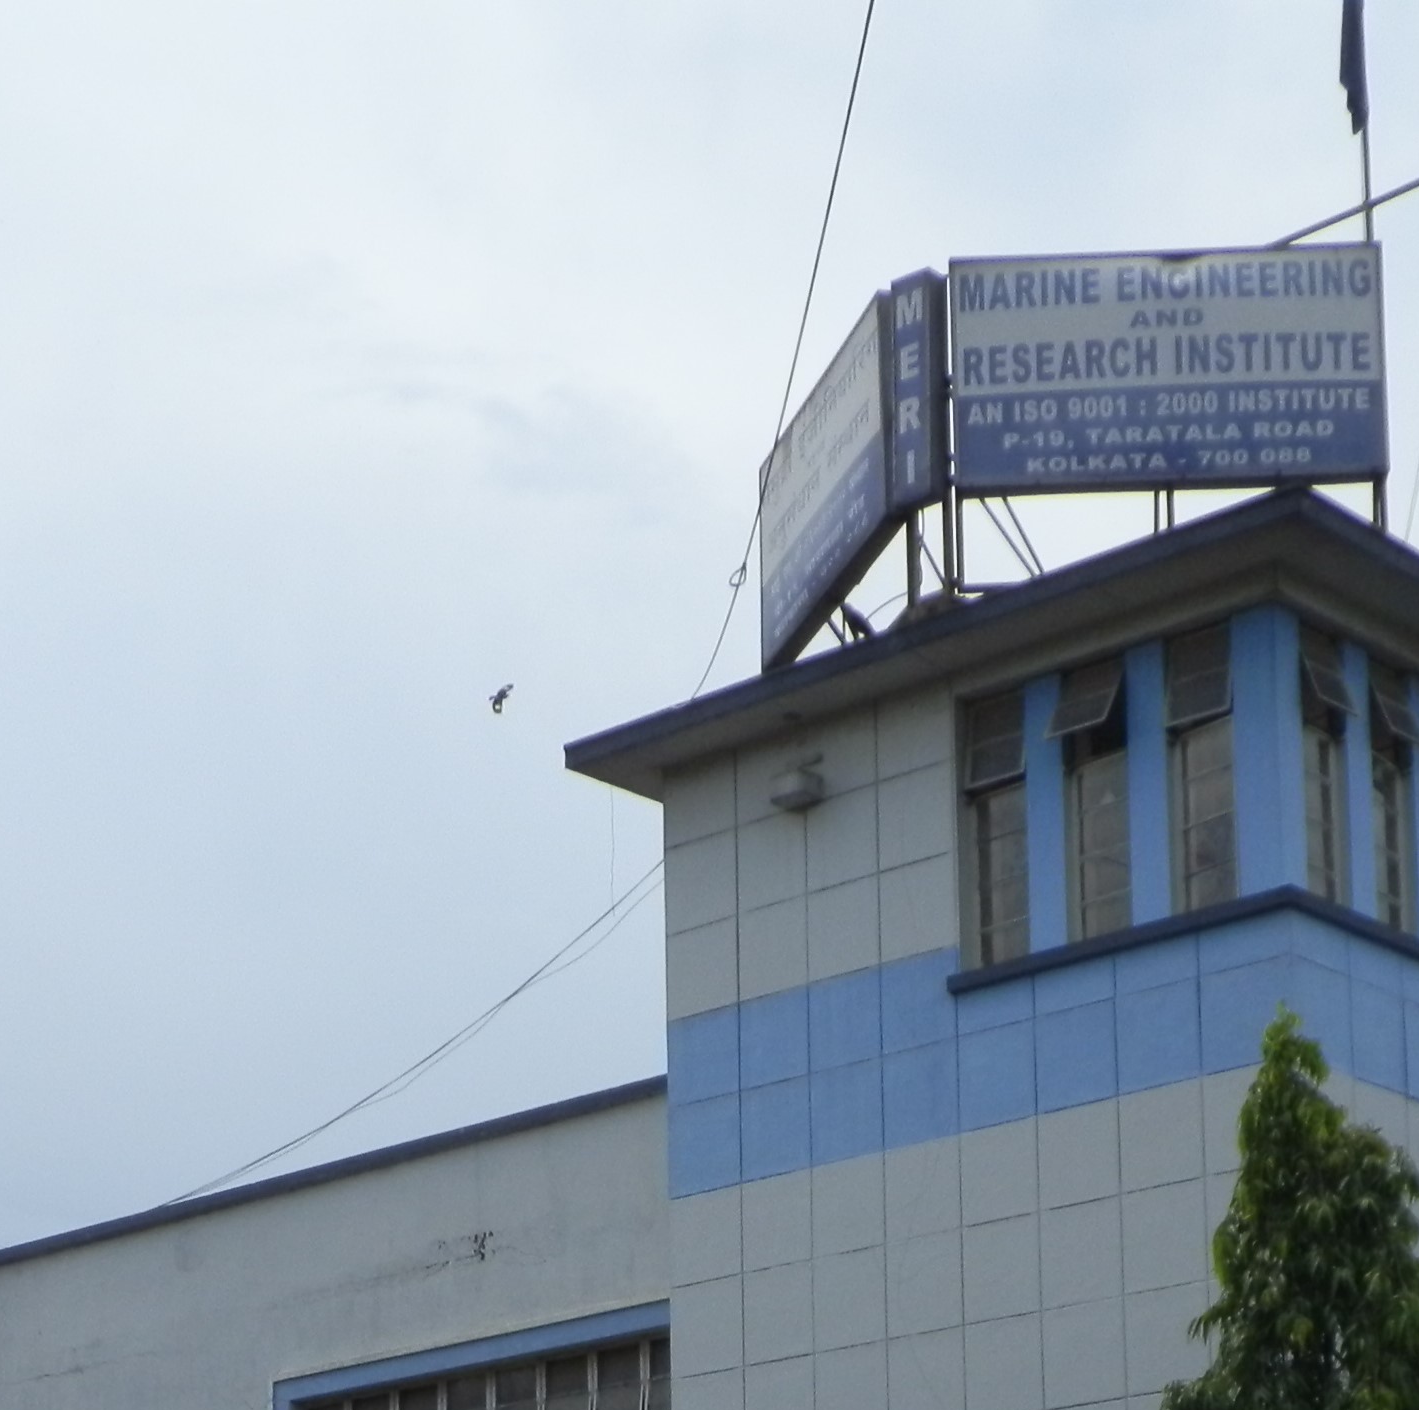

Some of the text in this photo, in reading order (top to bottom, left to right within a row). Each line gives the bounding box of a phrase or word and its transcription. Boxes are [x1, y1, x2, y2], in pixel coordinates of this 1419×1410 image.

[959, 258, 1371, 312] MARINE ENGINEERING
[1130, 308, 1204, 328] AND
[963, 331, 1371, 386] RESEARCH INSTITUTE
[896, 287, 924, 485] MERI
[967, 402, 1003, 425] AN
[1014, 399, 1058, 422] ISO
[1068, 395, 1127, 420] 9001
[1156, 390, 1219, 416] 2000
[1230, 388, 1370, 413] INSTITUTE
[1085, 422, 1241, 445] TARATALA
[1253, 420, 1334, 438] ROAD
[1027, 453, 1167, 473] KOLKATA
[1198, 448, 1249, 466] 700
[1260, 446, 1312, 465] 088
